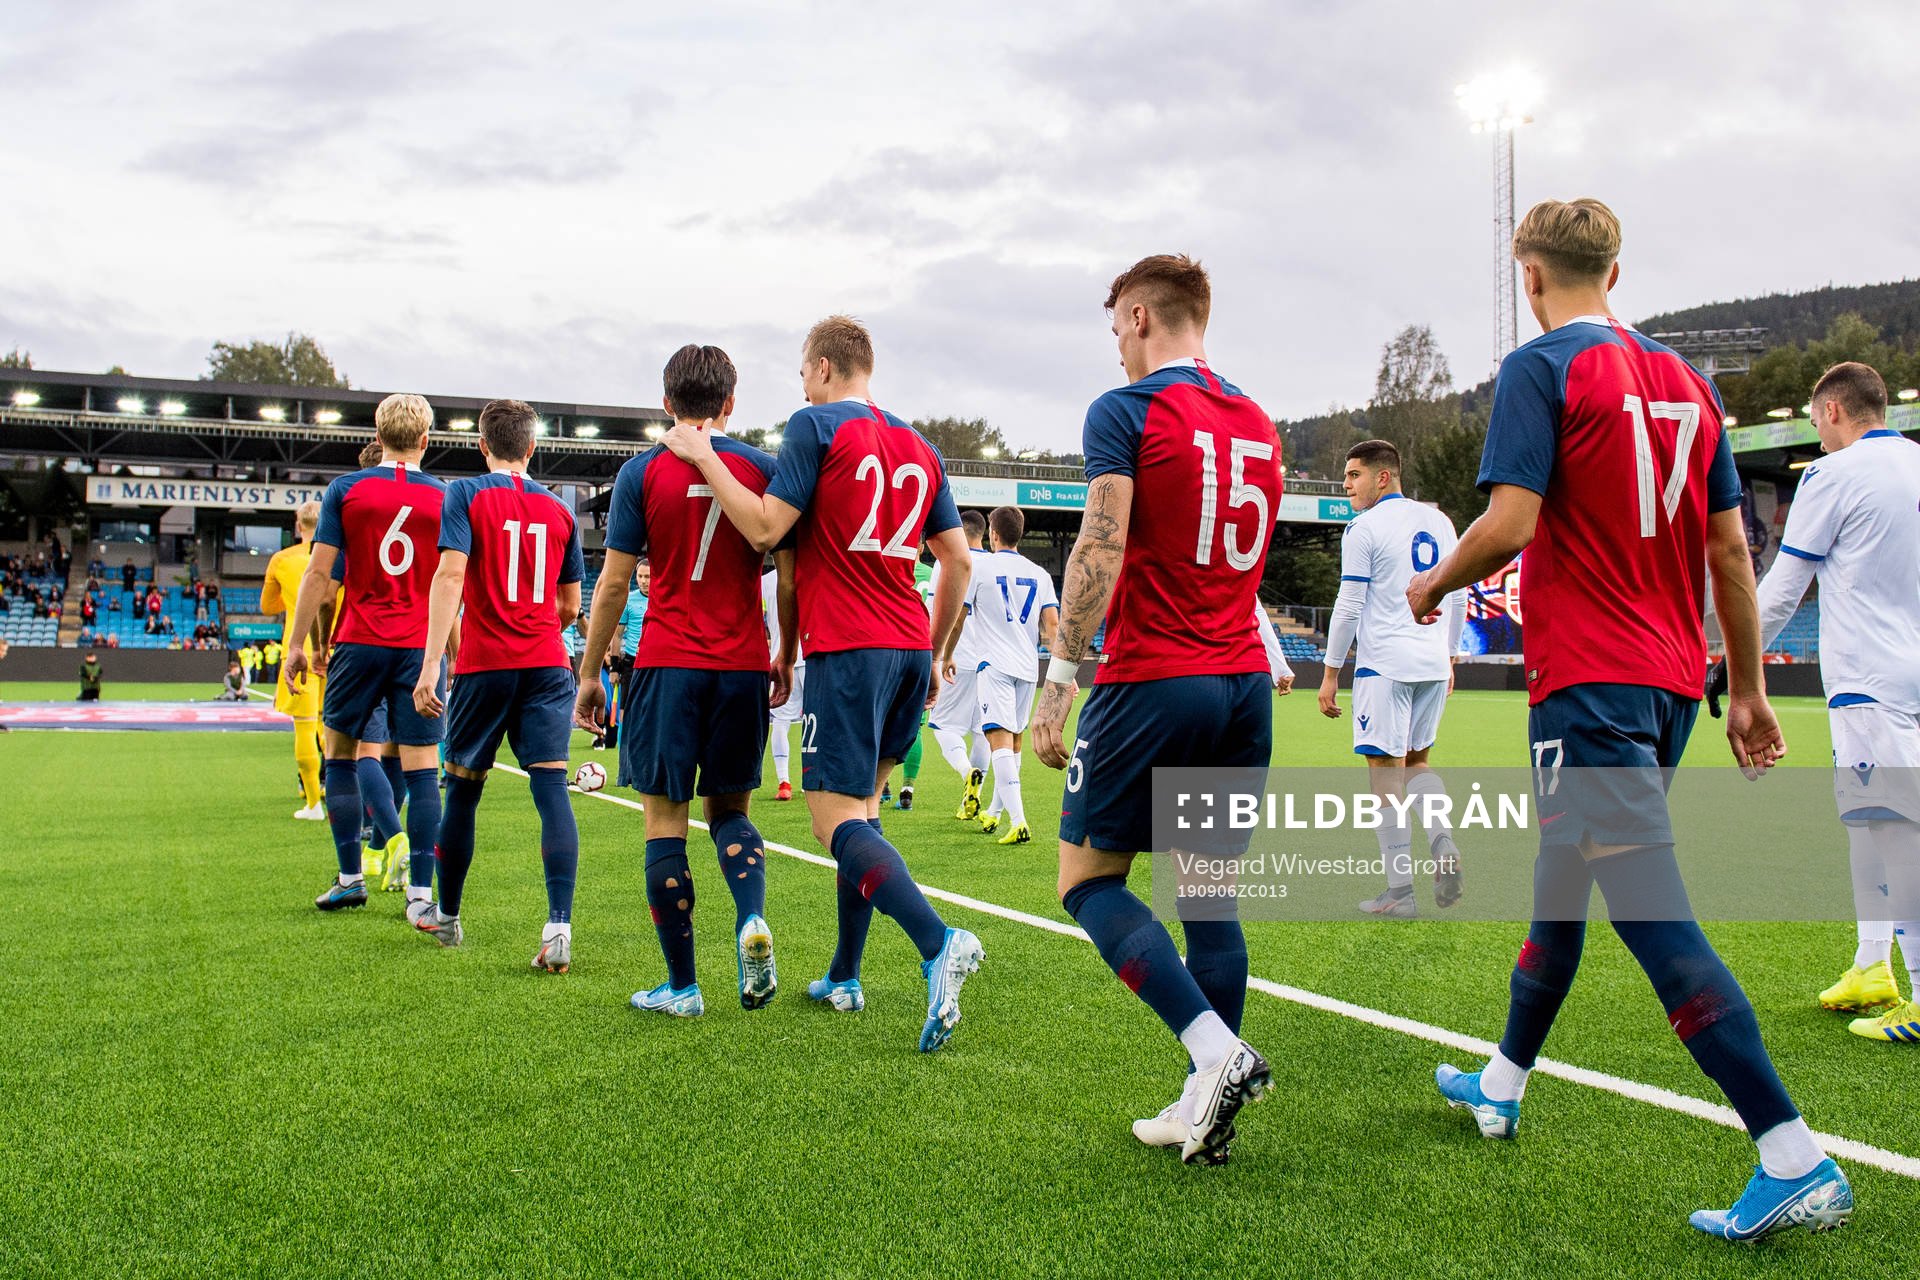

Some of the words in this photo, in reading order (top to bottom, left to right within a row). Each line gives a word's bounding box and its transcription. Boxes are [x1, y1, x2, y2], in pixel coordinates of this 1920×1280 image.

[122, 482, 275, 504] MARIENLYST
[1030, 487, 1052, 502] DNB
[1623, 394, 1700, 537] 17
[686, 484, 721, 581] 7
[847, 454, 928, 560] 22
[1193, 430, 1273, 571] 15
[1329, 502, 1349, 517] DNB
[379, 506, 415, 576] 6
[503, 520, 547, 604] 11
[995, 575, 1038, 625] 17
[801, 713, 817, 753] 22
[1532, 739, 1564, 797] 17
